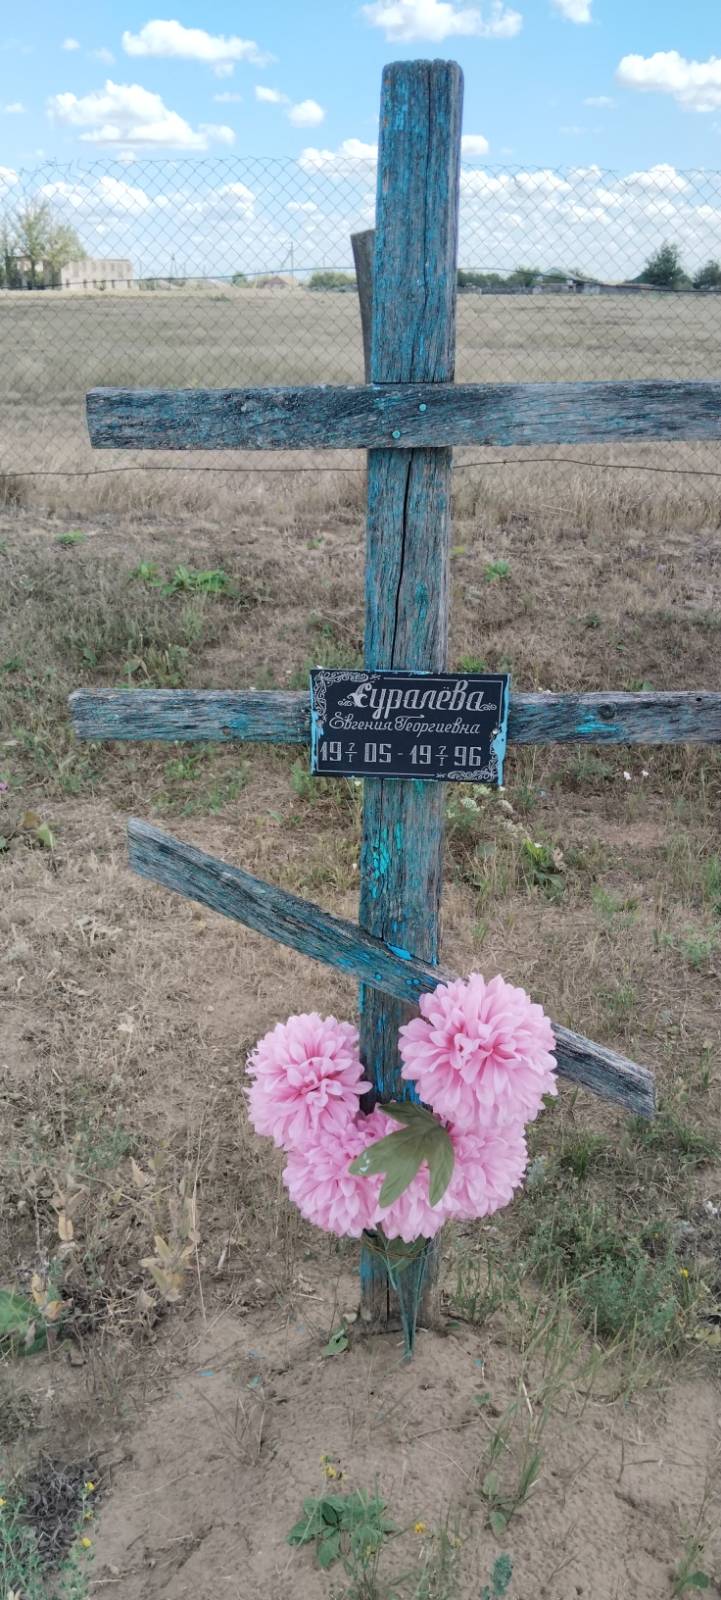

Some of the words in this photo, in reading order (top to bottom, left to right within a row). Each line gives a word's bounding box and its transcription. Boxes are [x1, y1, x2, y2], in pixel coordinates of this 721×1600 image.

[329, 711, 393, 732] Евгения
[394, 714, 481, 738] Георгиевна
[319, 741, 342, 762] 19
[363, 742, 392, 763] 05
[408, 745, 432, 765] 19
[453, 746, 482, 767] 96
